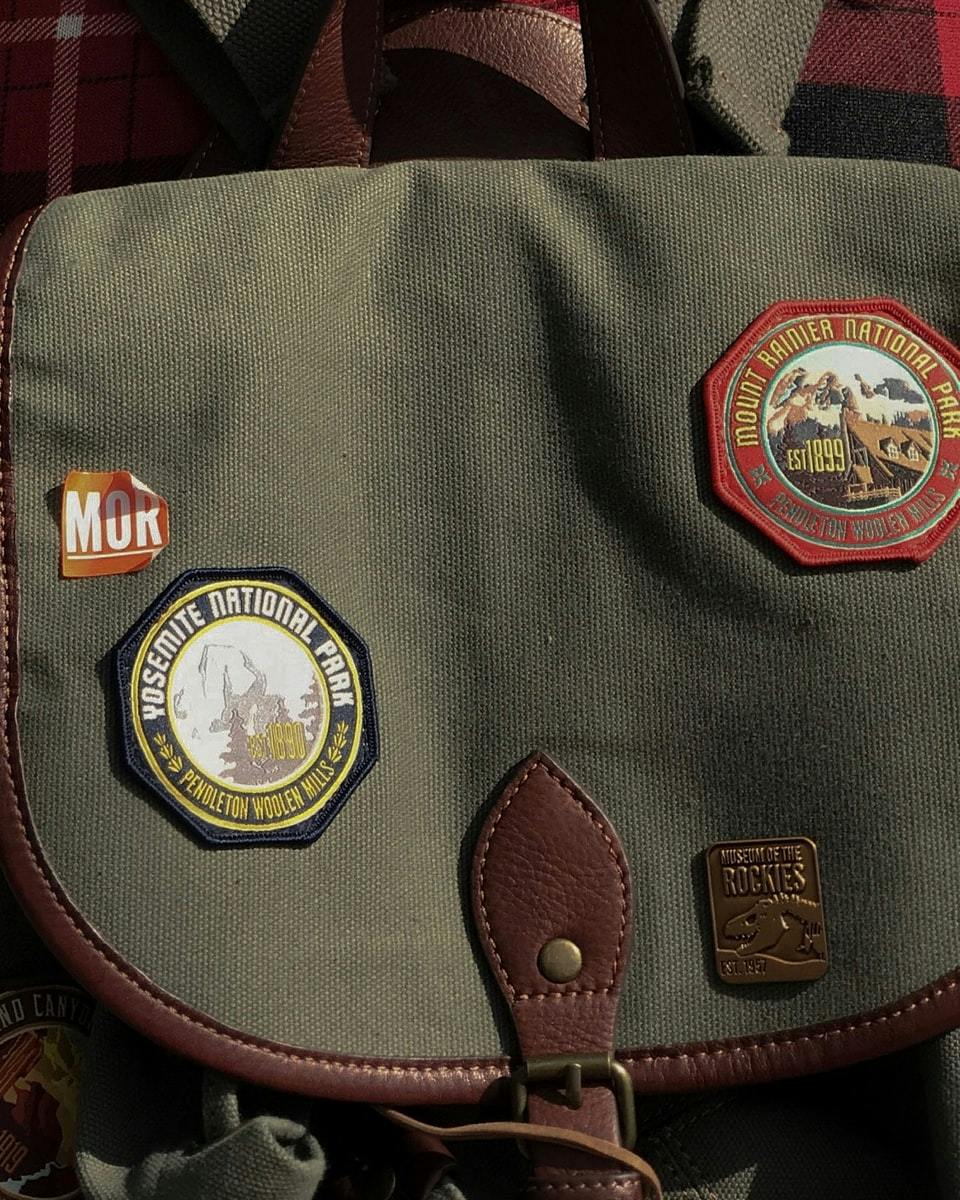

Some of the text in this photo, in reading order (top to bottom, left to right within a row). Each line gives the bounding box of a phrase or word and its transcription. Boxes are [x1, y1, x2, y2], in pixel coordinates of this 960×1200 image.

[734, 318, 960, 447] MOUNT RAINIER NATIONAL PARK
[66, 490, 162, 553] MOR
[769, 487, 946, 541] PENDLETON WOOLEN MILLS
[141, 587, 355, 719] YOSEMITE NATIONAL PARK
[180, 760, 336, 820] PENDLETON WOOLEN MILLS
[720, 845, 802, 864] MUSEUM OF THE
[722, 863, 807, 897] ROCKIES
